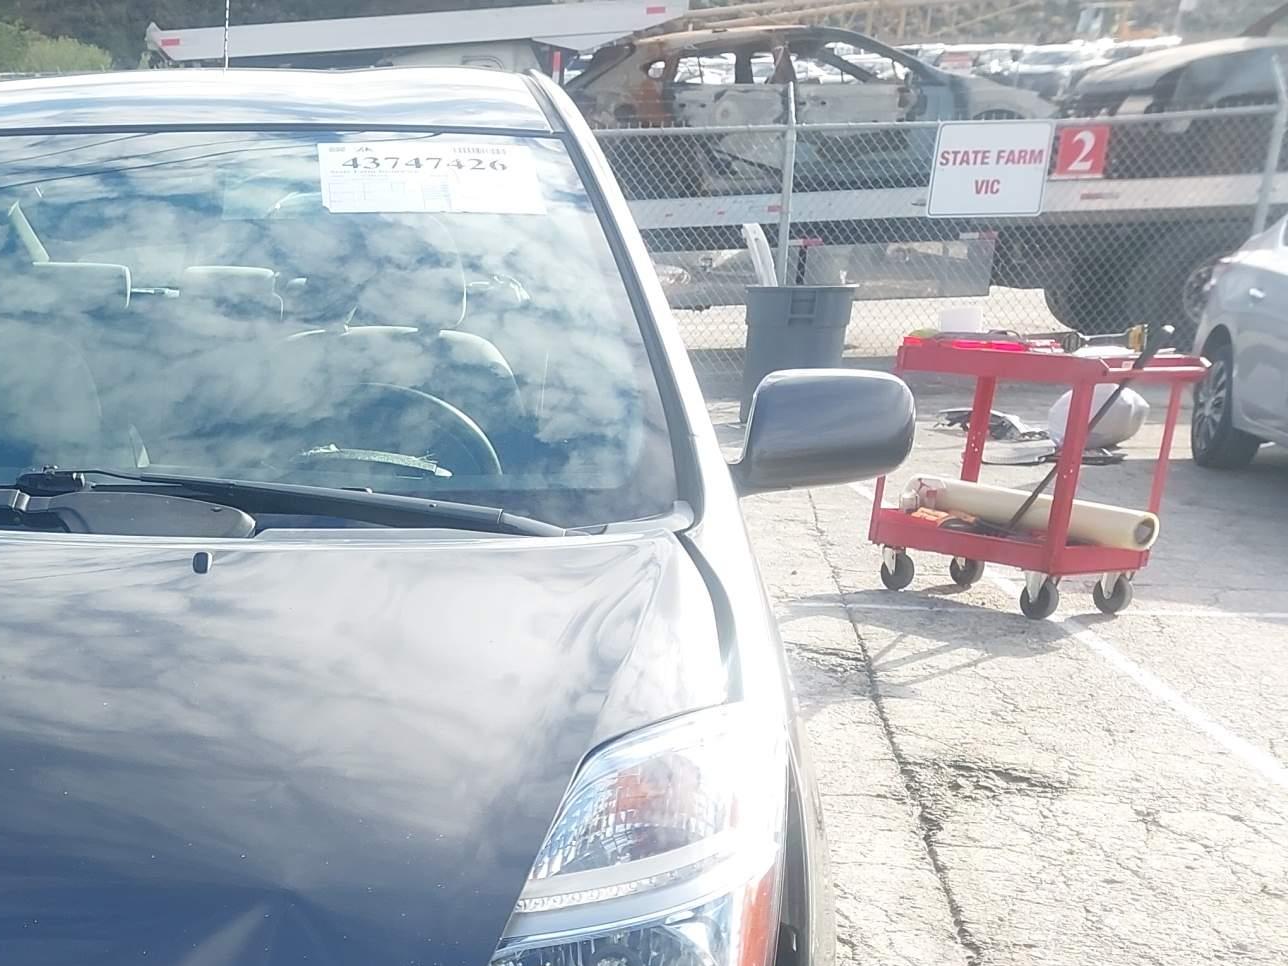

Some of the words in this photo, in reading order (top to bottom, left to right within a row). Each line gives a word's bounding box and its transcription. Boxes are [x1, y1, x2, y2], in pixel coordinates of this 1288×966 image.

[939, 150, 990, 166] STATE
[995, 149, 1044, 165] FARM
[1067, 130, 1096, 171] 2
[342, 156, 508, 171] 43747426
[974, 179, 1001, 195] VIC
